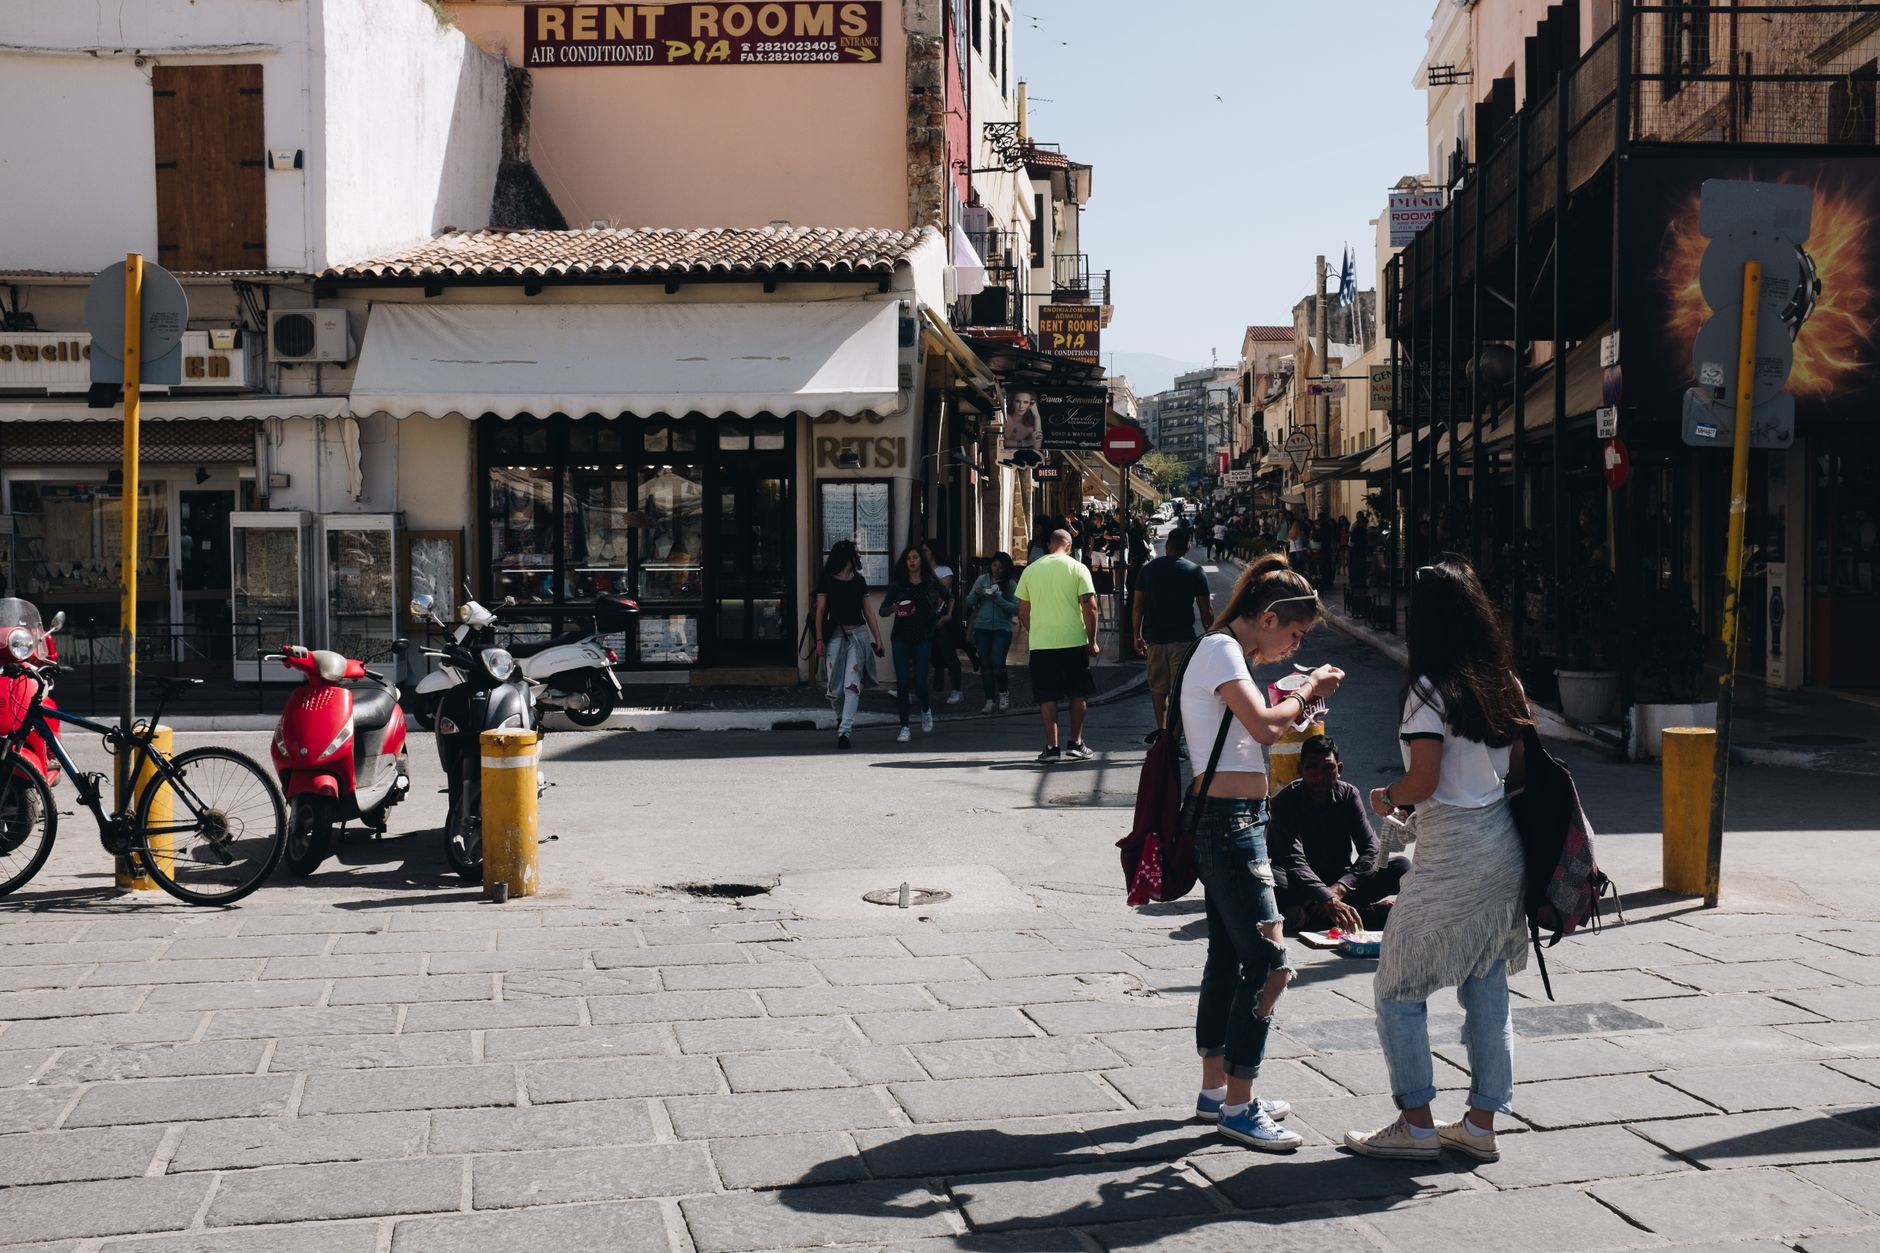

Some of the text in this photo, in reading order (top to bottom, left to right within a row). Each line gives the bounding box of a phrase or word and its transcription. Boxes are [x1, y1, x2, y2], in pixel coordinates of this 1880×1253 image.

[537, 4, 868, 40] RENT ROOMS
[756, 42, 837, 52] 2821023405
[840, 36, 879, 46] ENTRANCE
[531, 45, 654, 62] AIR CONDITIONED
[665, 40, 731, 62] PIA
[1040, 320, 1099, 332] RENT ROOMS
[1053, 333, 1085, 349] PIA
[1038, 469, 1058, 477] DIESEL
